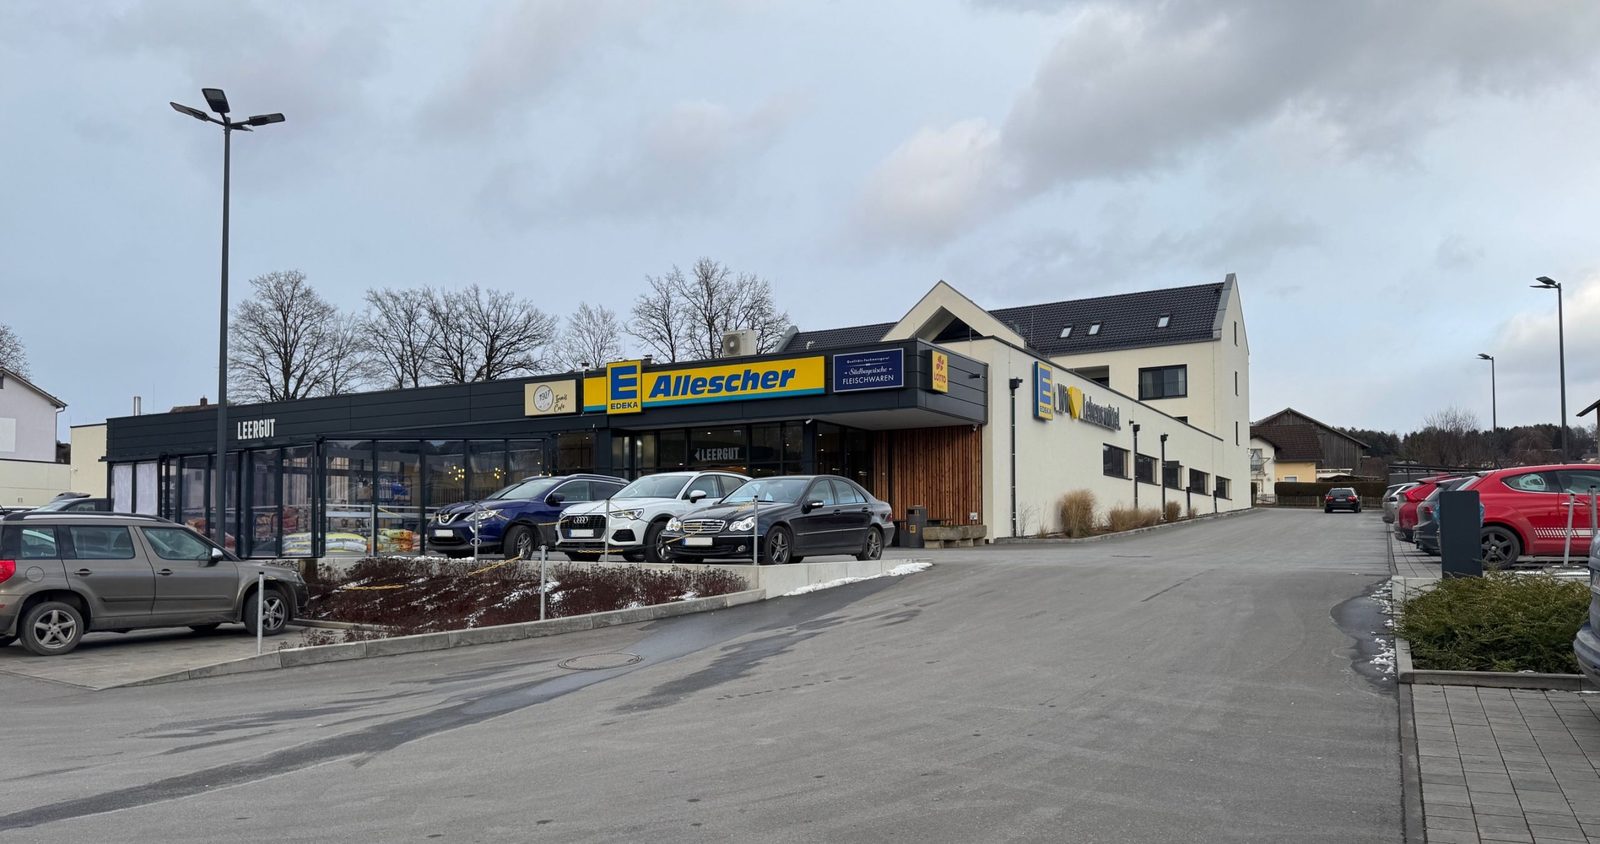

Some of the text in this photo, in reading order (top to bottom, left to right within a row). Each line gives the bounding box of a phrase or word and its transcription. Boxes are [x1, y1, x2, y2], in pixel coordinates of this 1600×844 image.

[611, 365, 638, 400] E
[649, 368, 796, 399] Allescher
[842, 374, 895, 385] FLEISCHWAREN
[610, 402, 639, 410] EDEKA
[237, 418, 276, 440] LEERGUT
[701, 447, 740, 461] LEERGUT
